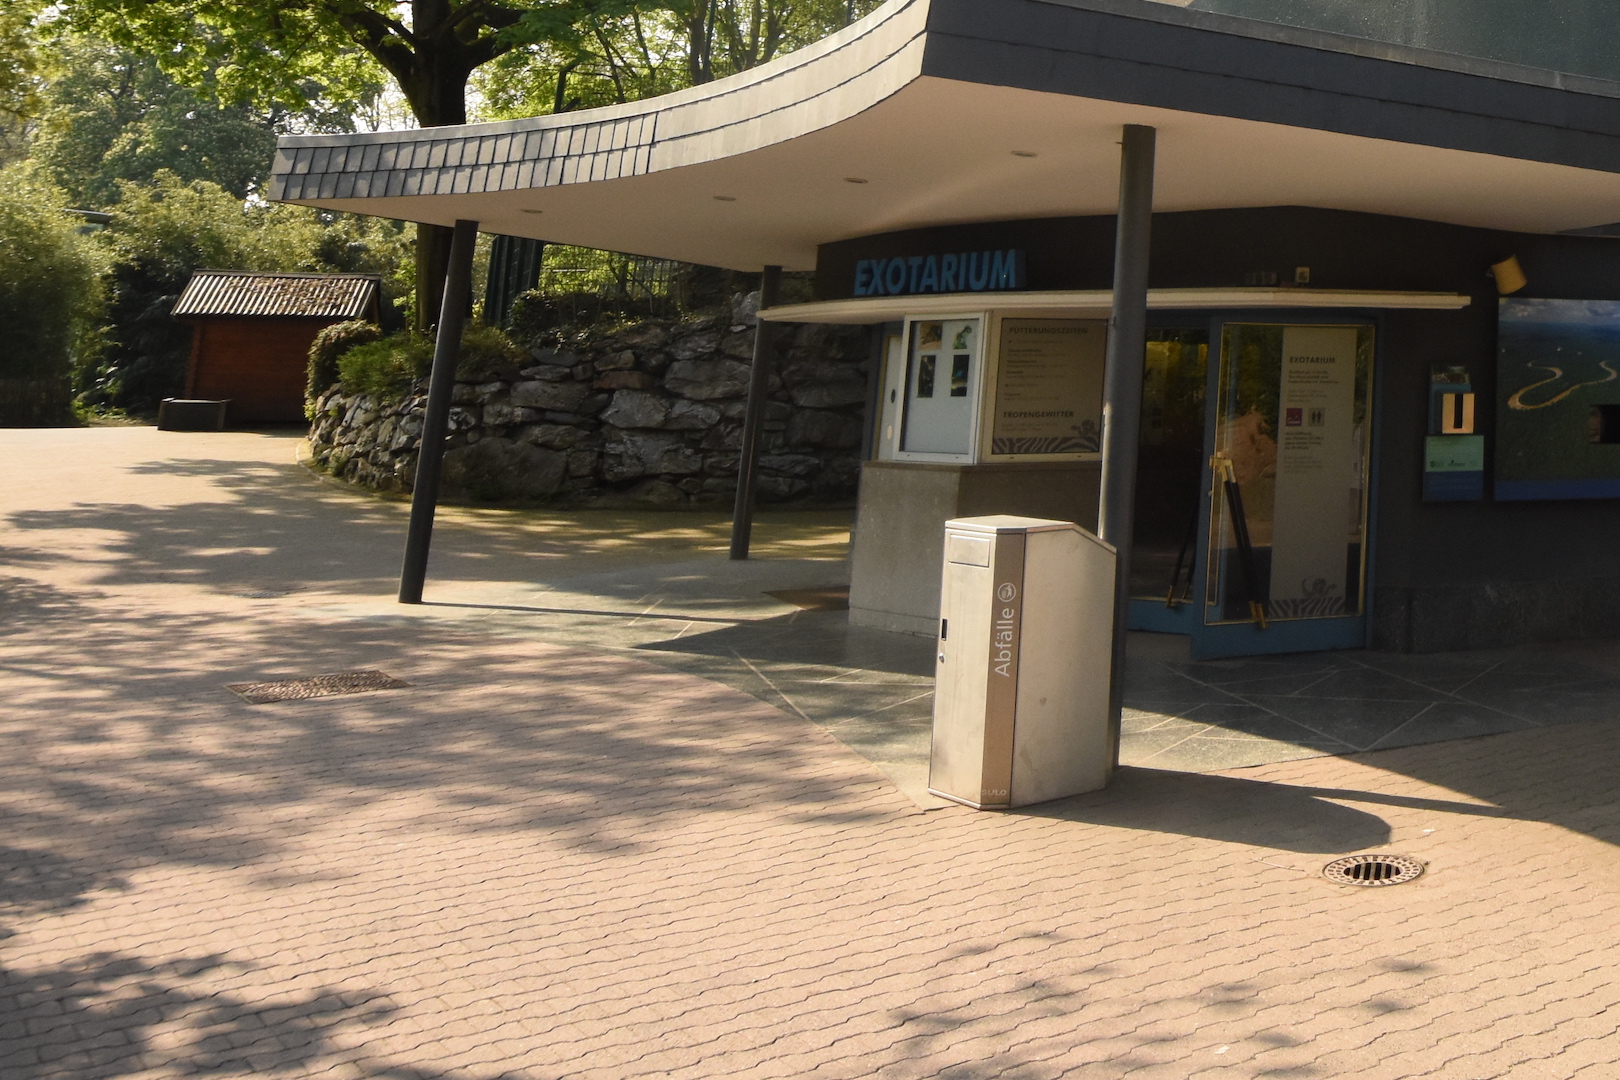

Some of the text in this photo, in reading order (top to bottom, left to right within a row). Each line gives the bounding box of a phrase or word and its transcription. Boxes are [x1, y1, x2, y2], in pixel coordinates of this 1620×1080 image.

[854, 249, 1016, 296] EXOTARIUM
[1009, 325, 1088, 335] FÜTTERUNGSZEITEN
[1289, 356, 1336, 364] EXOTARIUM
[1003, 410, 1074, 418] TROPENGEWITTER
[994, 608, 1014, 677] Abfälle
[981, 788, 1007, 796] SULO
